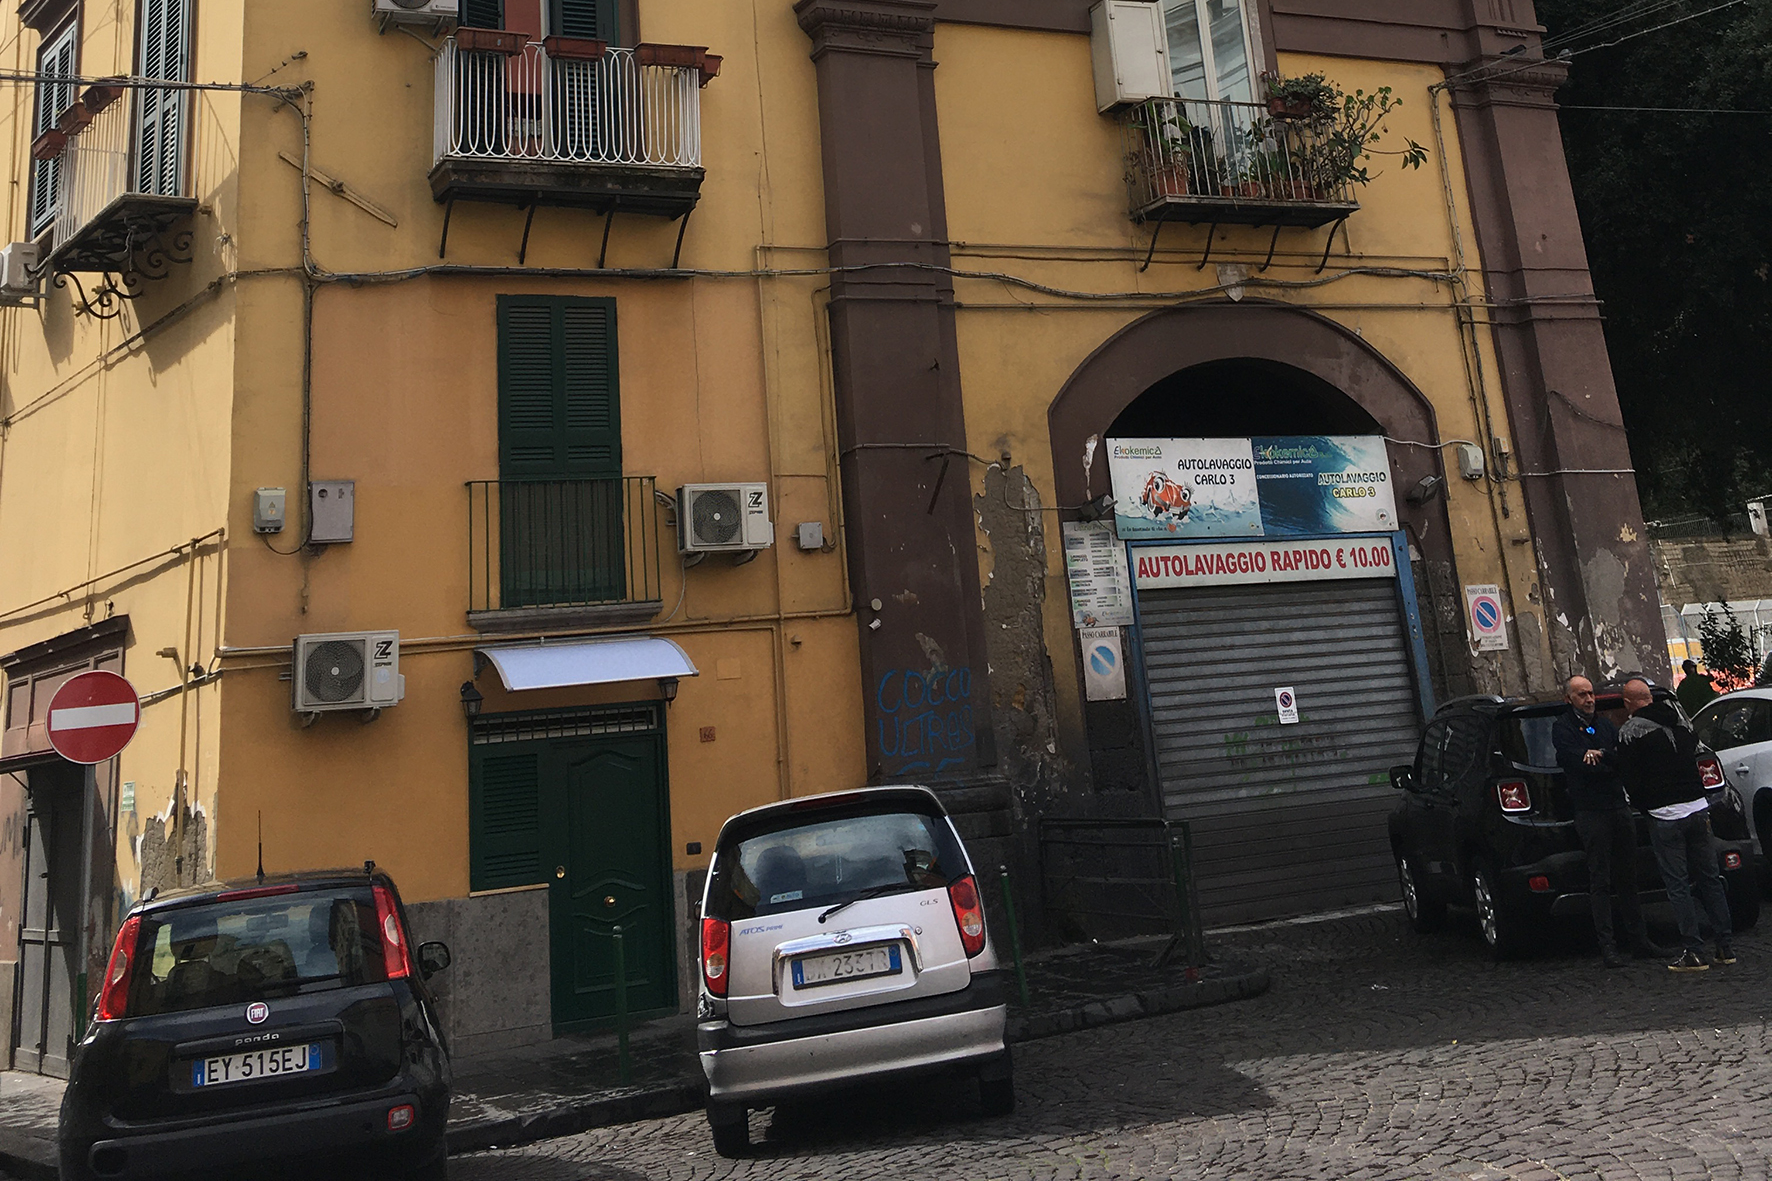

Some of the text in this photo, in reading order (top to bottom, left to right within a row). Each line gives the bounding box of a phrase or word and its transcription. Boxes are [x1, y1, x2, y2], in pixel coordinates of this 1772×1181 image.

[1177, 458, 1253, 470] AUTOLAVAGGIO
[1194, 474, 1236, 485] CARLO 3
[1318, 472, 1387, 486] AUTOLAVAGGIO
[1332, 486, 1377, 498] CARLO 3
[1138, 551, 1266, 579] AUTOLAVAGGIO
[1270, 548, 1332, 572] RAPIDO
[1336, 548, 1347, 569] €
[1349, 546, 1390, 568] 10.00
[1082, 630, 1095, 639] PASSO
[920, 898, 939, 906] GLS
[739, 925, 765, 936] ATOS
[250, 1007, 264, 1019] FIAT
[235, 1033, 280, 1046] panda
[207, 1057, 233, 1083] EY
[241, 1046, 307, 1077] 515EJ
